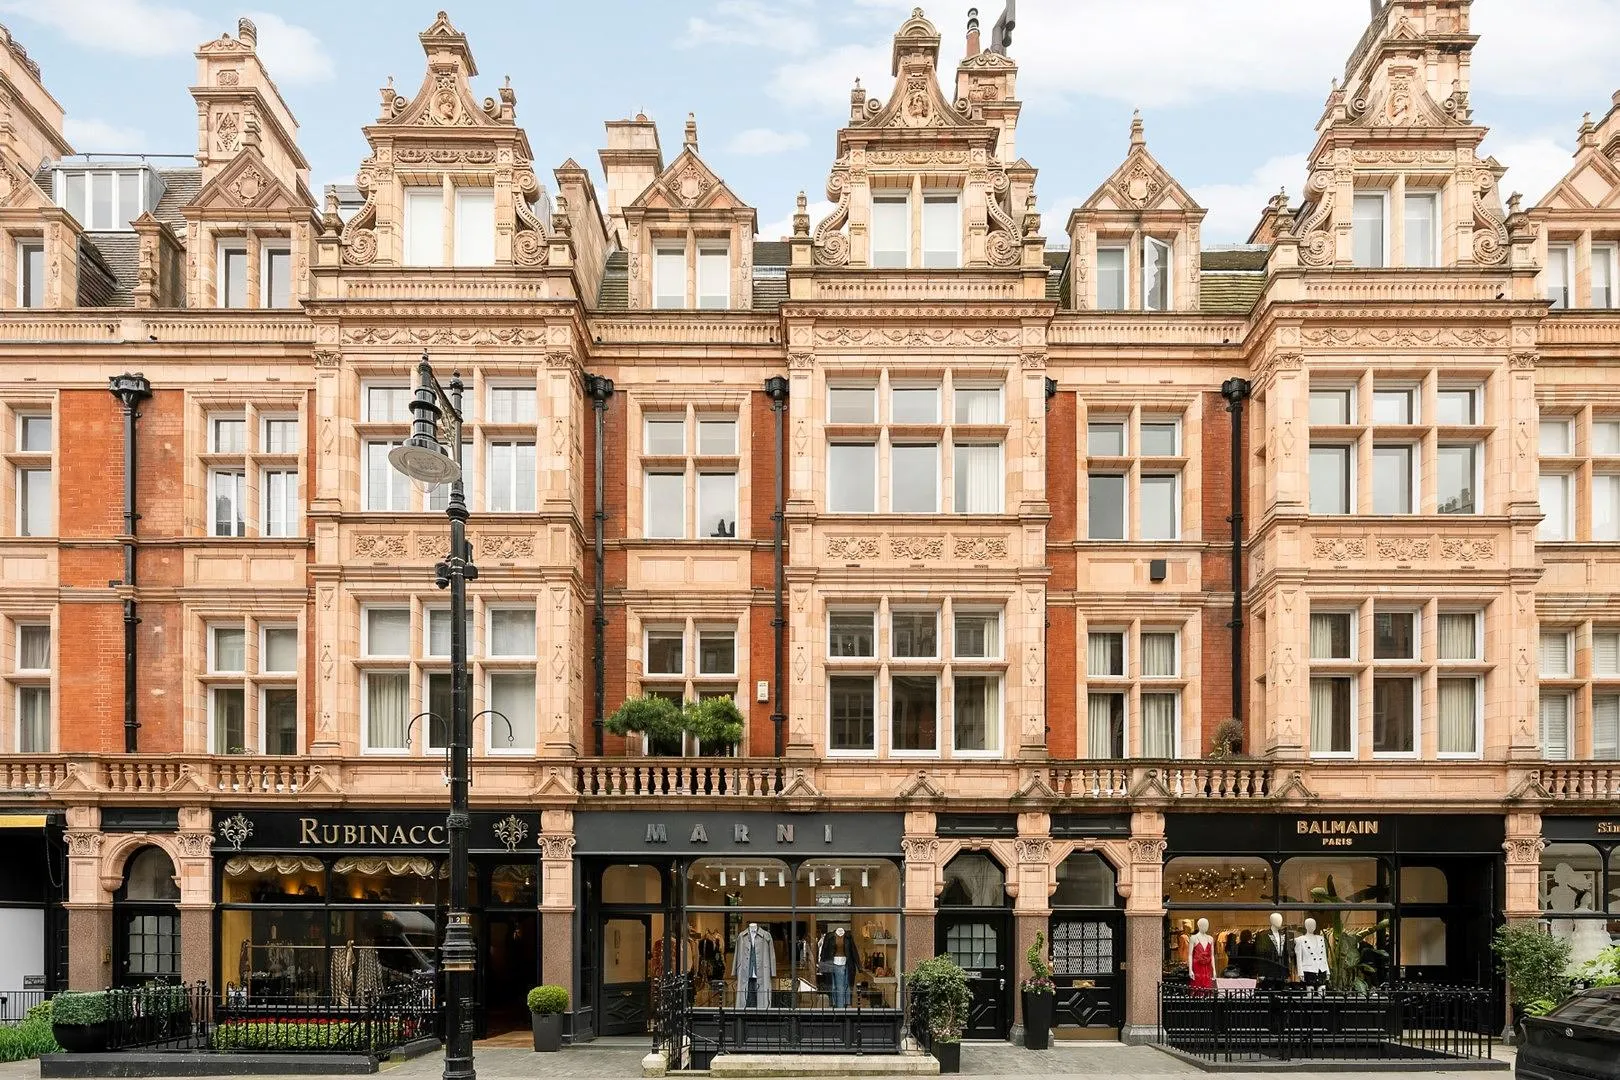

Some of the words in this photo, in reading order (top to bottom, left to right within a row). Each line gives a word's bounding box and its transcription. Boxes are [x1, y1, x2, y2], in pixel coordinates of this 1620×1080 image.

[299, 817, 450, 845] RUBINACC
[645, 823, 833, 843] MARNI
[1296, 820, 1379, 834] BALMAIN
[1322, 838, 1353, 846] PARIS
